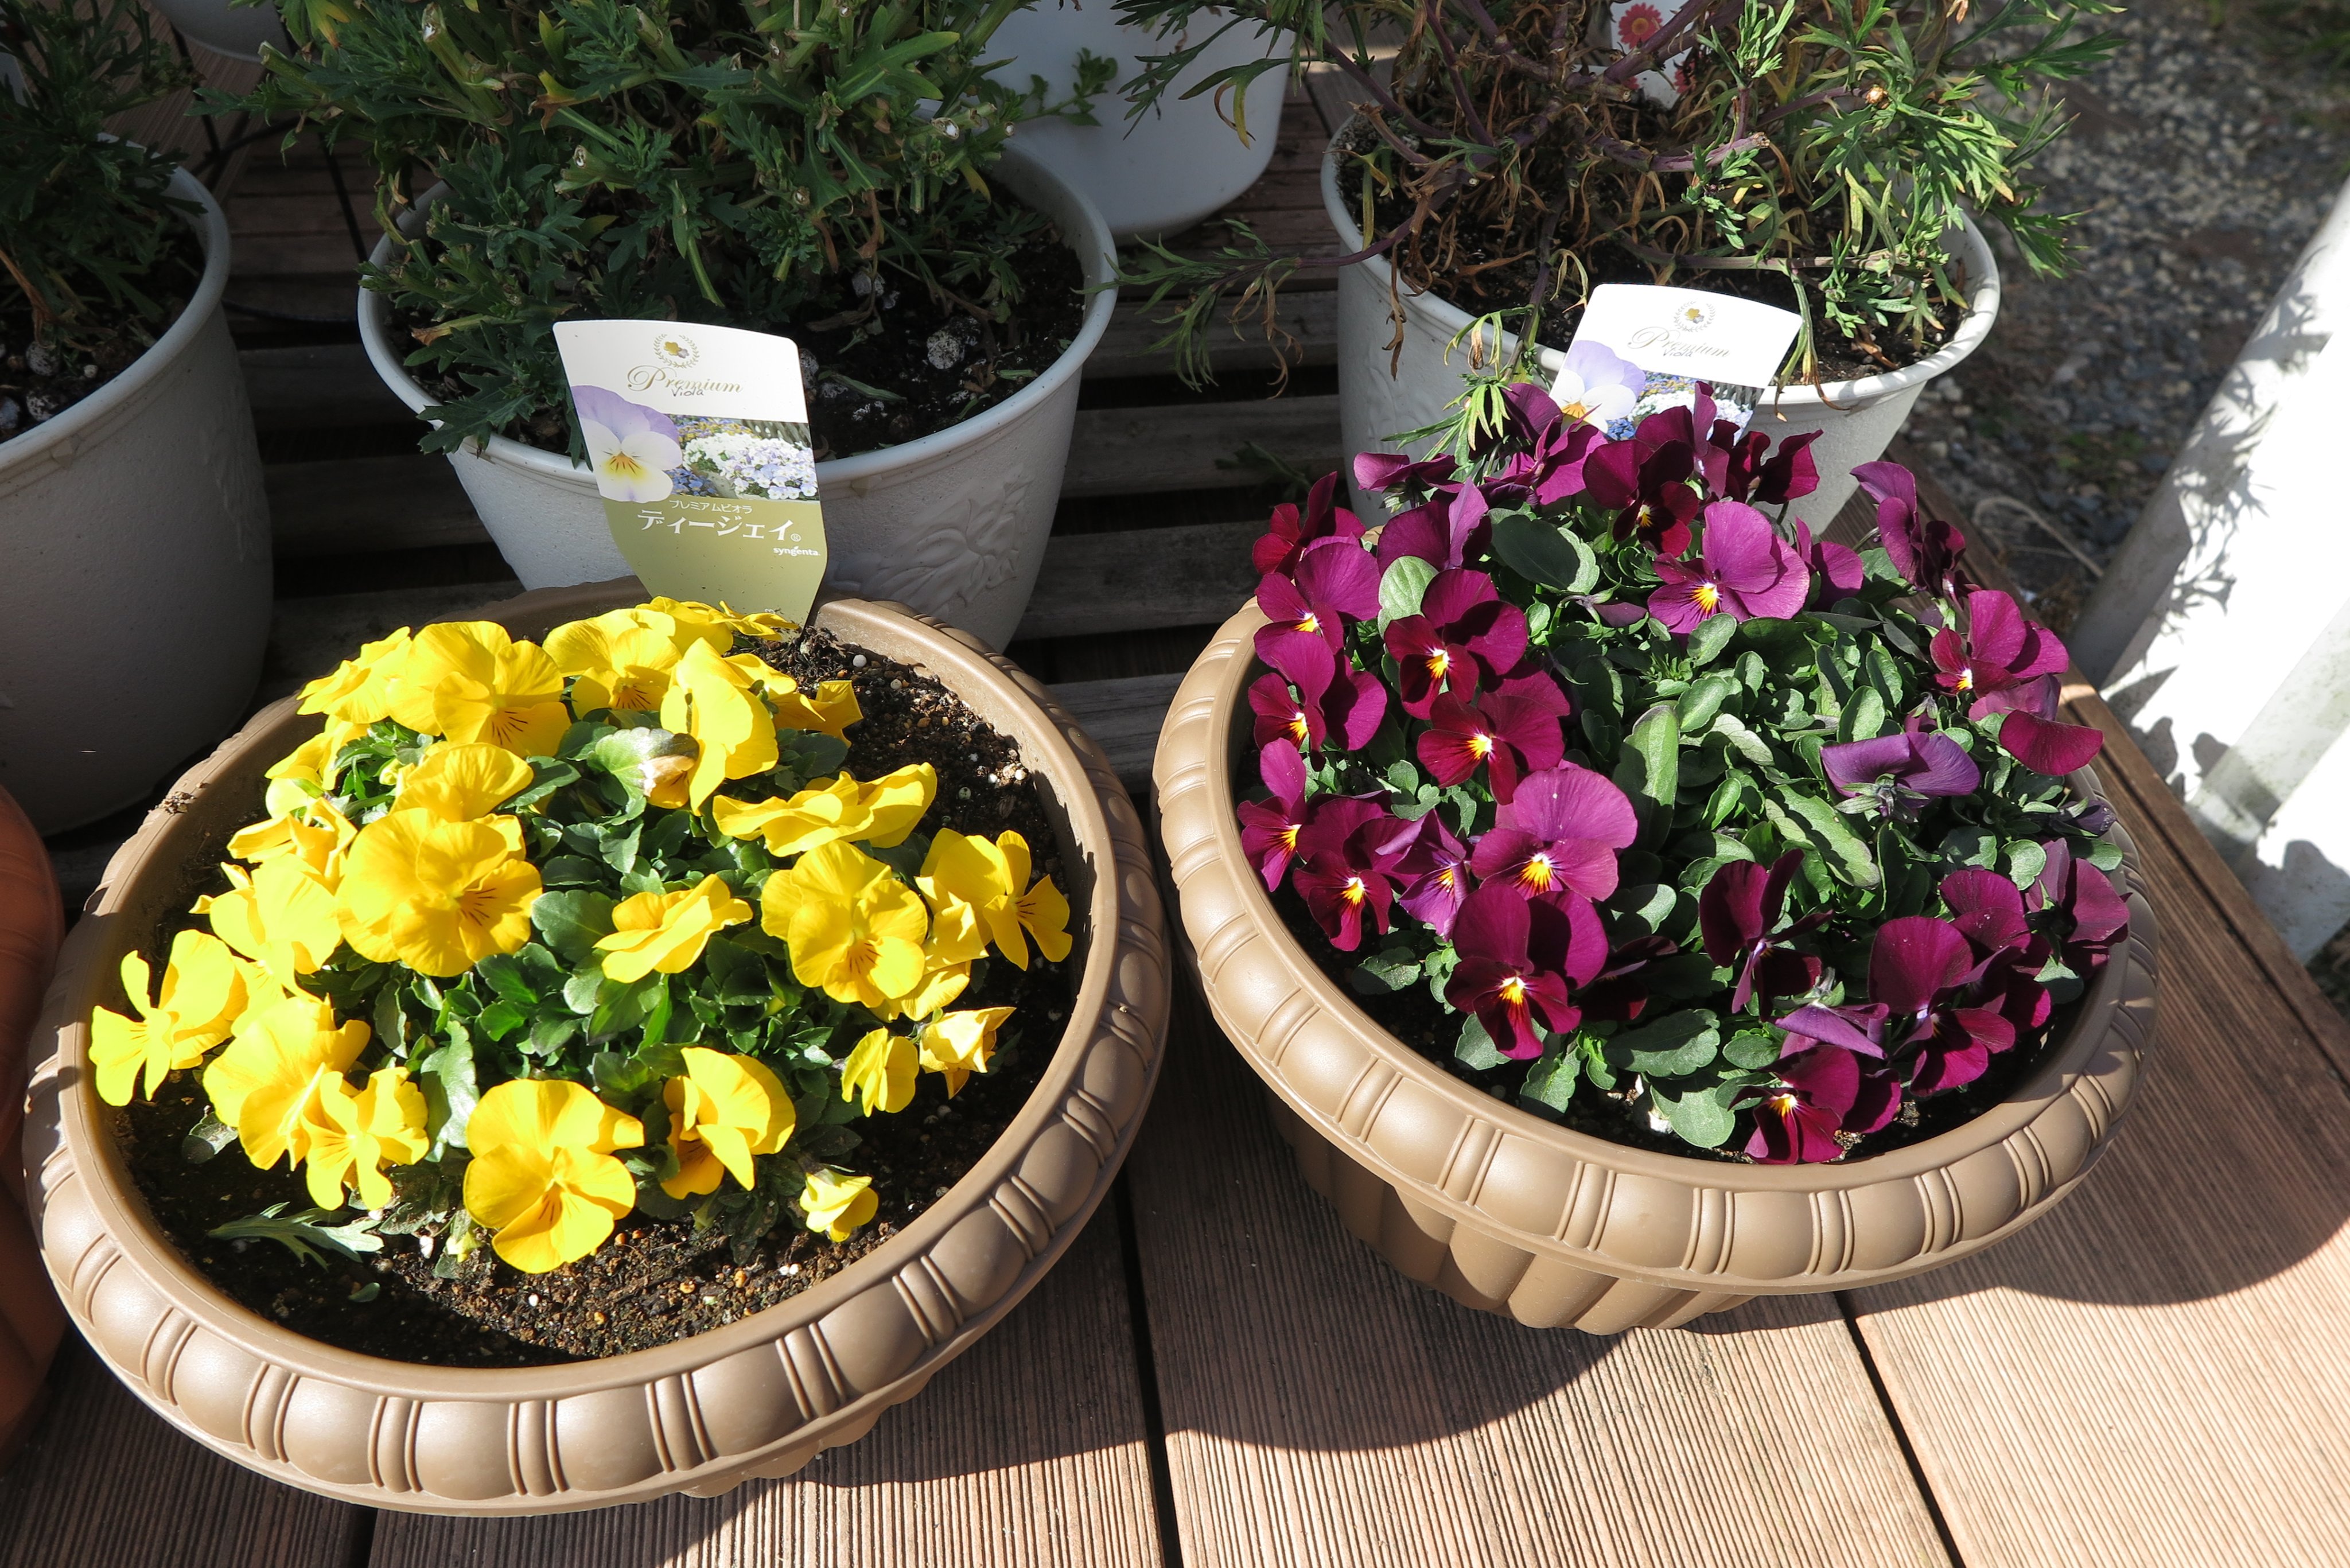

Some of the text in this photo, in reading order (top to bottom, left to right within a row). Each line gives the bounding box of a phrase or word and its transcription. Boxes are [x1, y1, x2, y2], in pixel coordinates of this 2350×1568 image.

[1627, 326, 1730, 357] Premium
[1663, 348, 1693, 357] Viola
[627, 365, 742, 392] Premium
[672, 386, 703, 397] Viola
[669, 500, 753, 514] プレミアムビオラ
